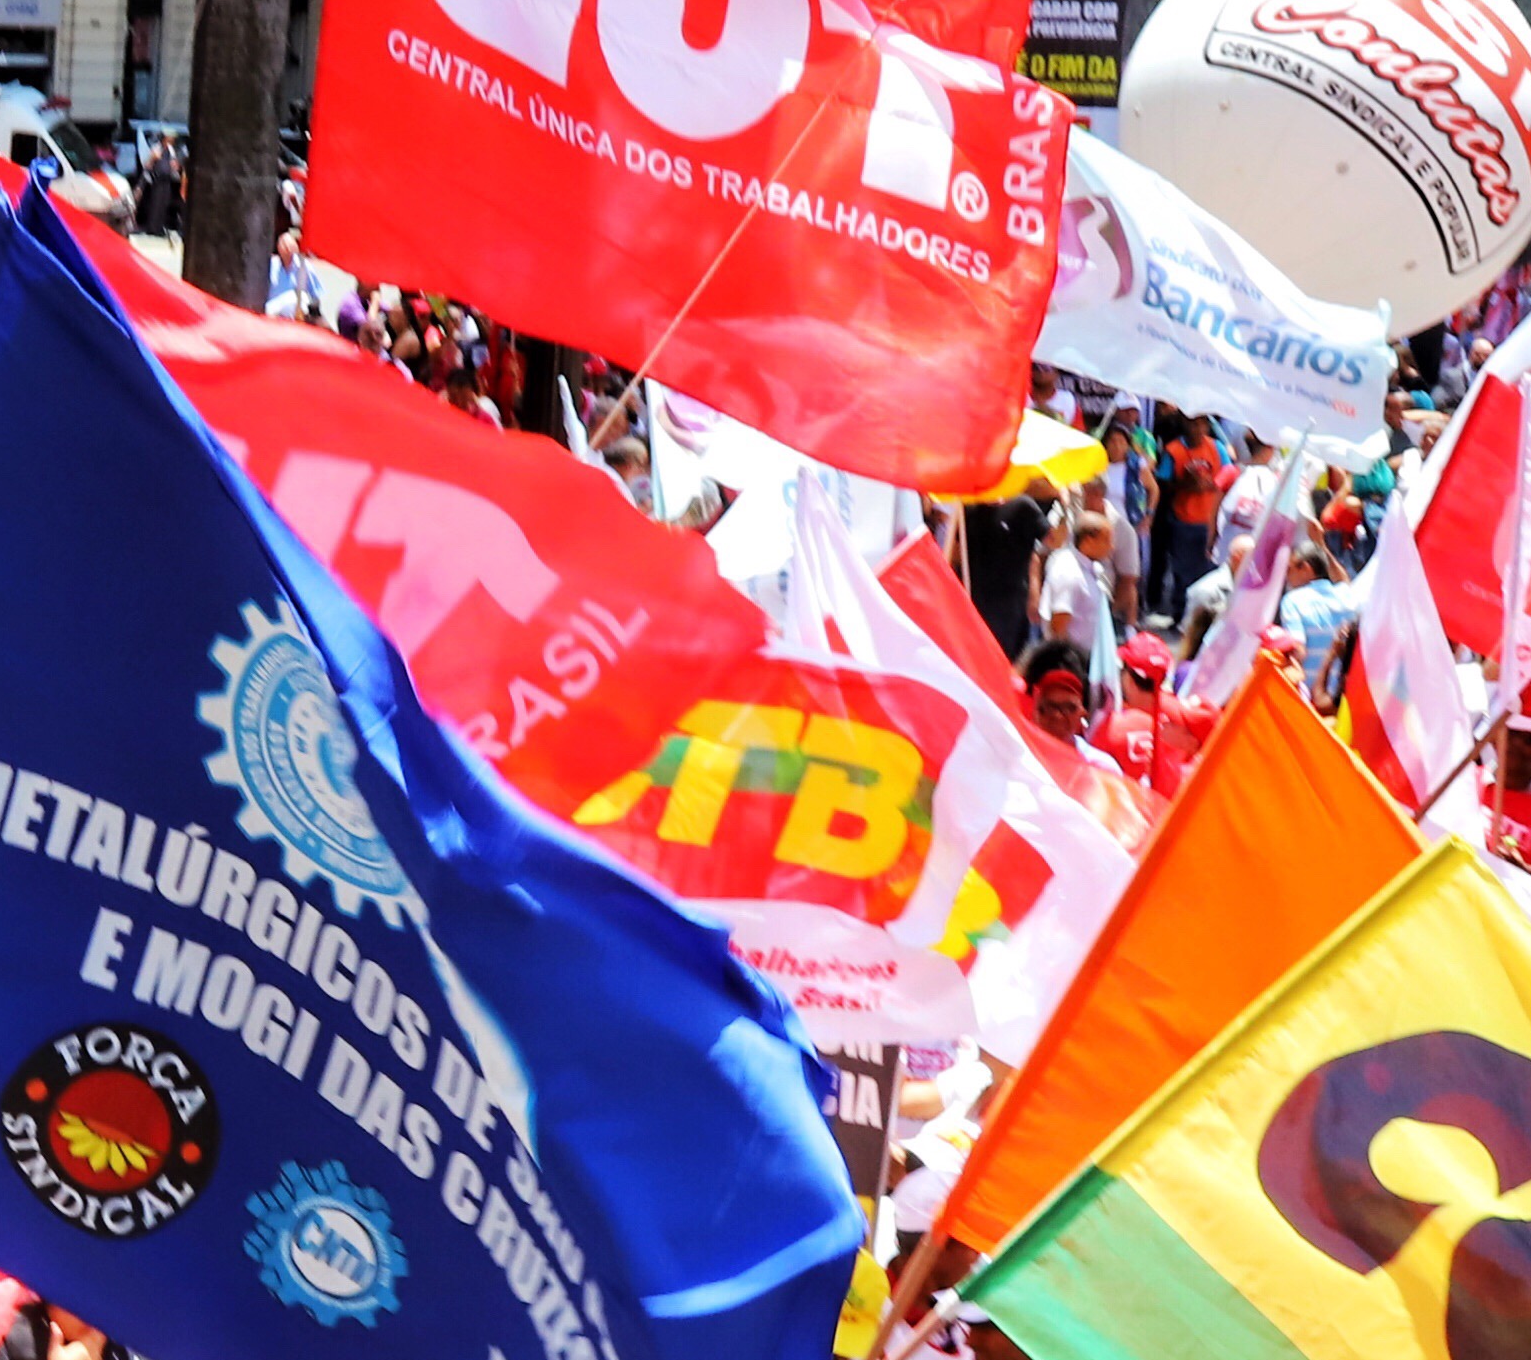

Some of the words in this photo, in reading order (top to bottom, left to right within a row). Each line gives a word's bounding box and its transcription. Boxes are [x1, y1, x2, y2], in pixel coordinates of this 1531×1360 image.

[386, 29, 525, 125] CENTRAL
[528, 91, 620, 166] ÚNICA
[624, 139, 696, 191] DOS
[700, 162, 994, 286] TRABALHADORES
[1220, 40, 1317, 86] CENTRAL
[1323, 79, 1414, 163] SINDICAL
[1415, 158, 1432, 180] E
[1427, 178, 1473, 262] POPULAR
[53, 1026, 208, 1125] FORÇA
[80, 905, 134, 990] E
[133, 926, 316, 1086] MOGI
[318, 1034, 442, 1181] DAS
[432, 1036, 501, 1153] DE
[1, 1110, 196, 1236] SINDICAL
